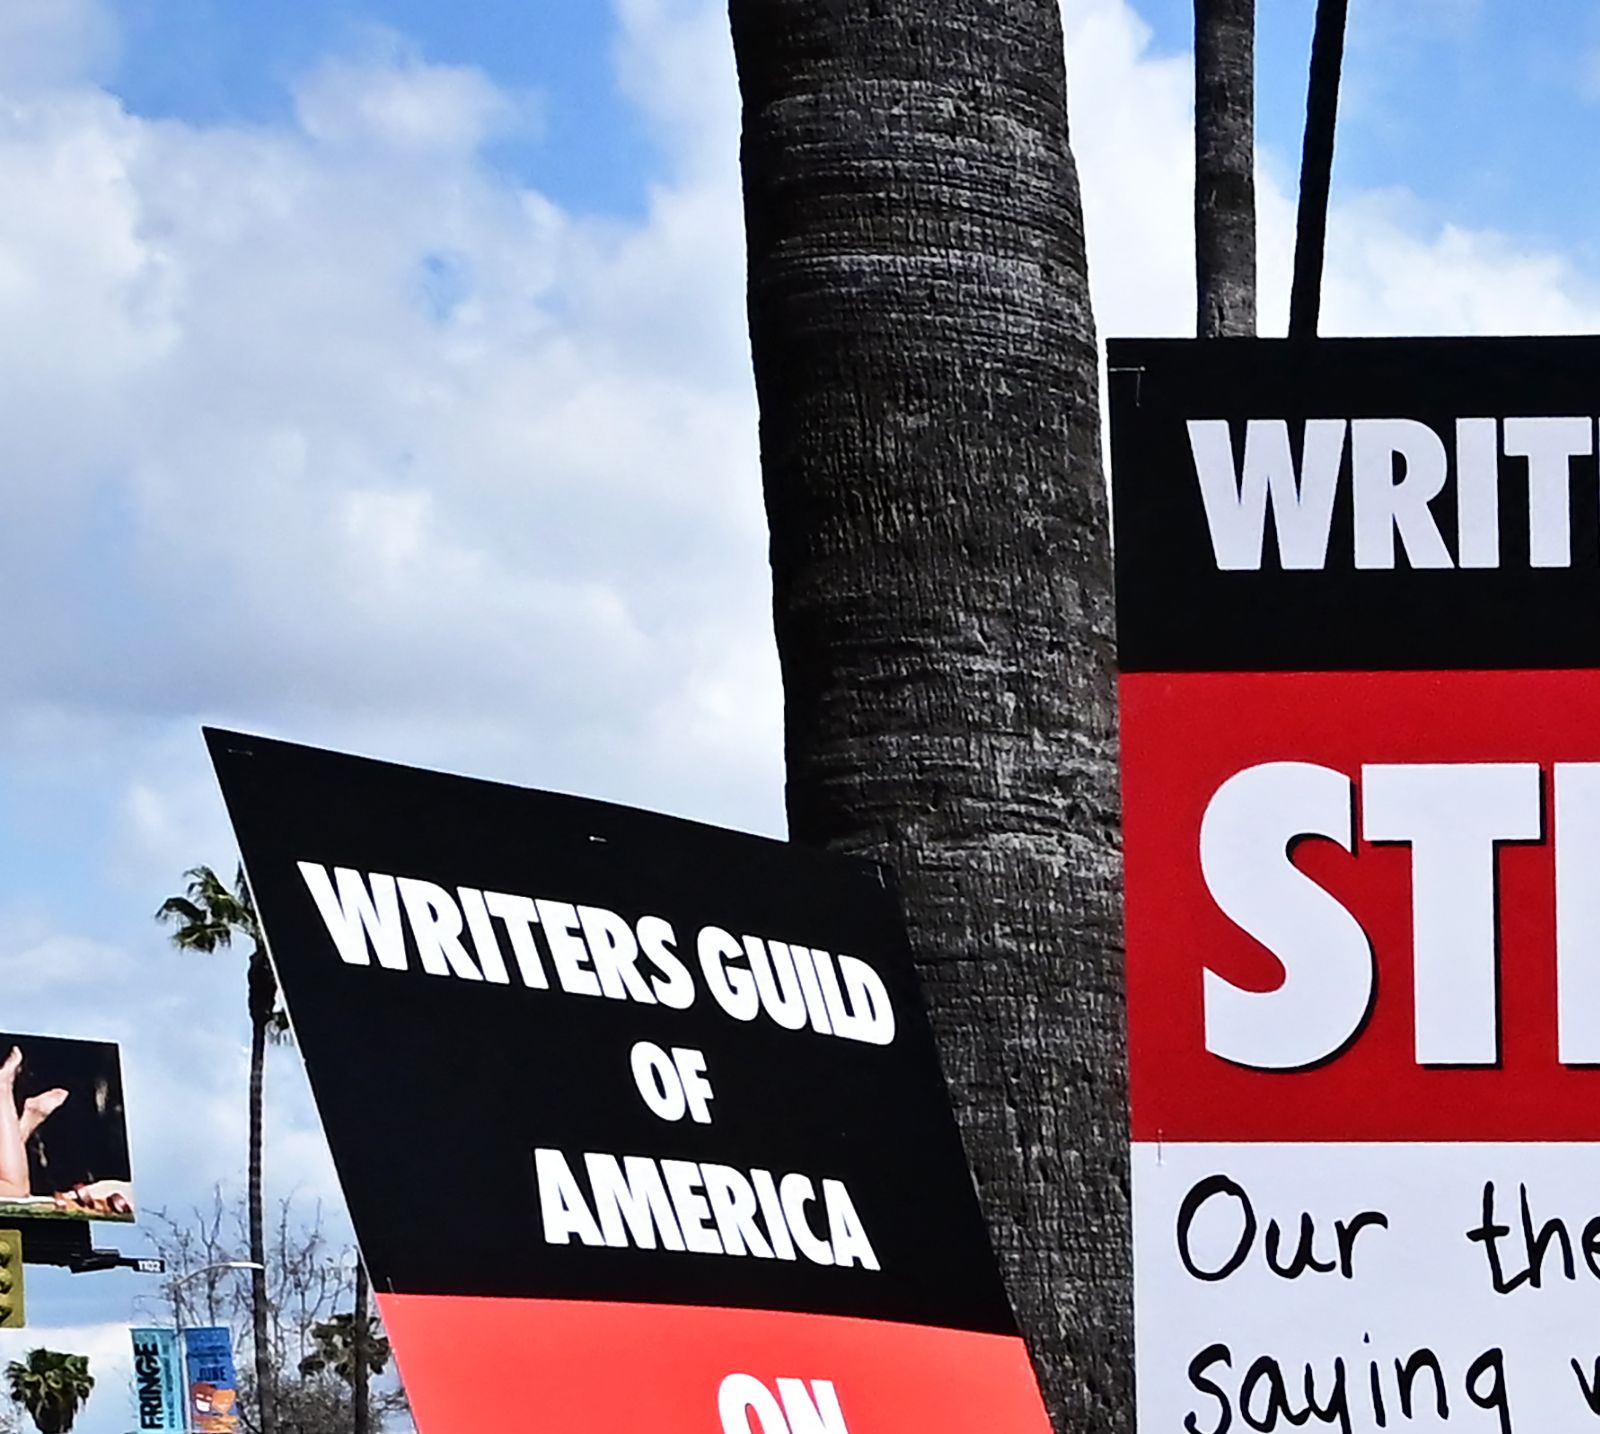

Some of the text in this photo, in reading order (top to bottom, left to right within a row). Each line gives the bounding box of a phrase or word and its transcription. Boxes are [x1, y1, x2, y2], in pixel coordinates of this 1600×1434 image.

[296, 861, 895, 1045] WRITERS GUILD
[630, 1041, 714, 1124] OF
[534, 1148, 881, 1271] AMERICA
[1177, 1175, 1388, 1281] Our
[134, 1342, 164, 1429] FRINGE
